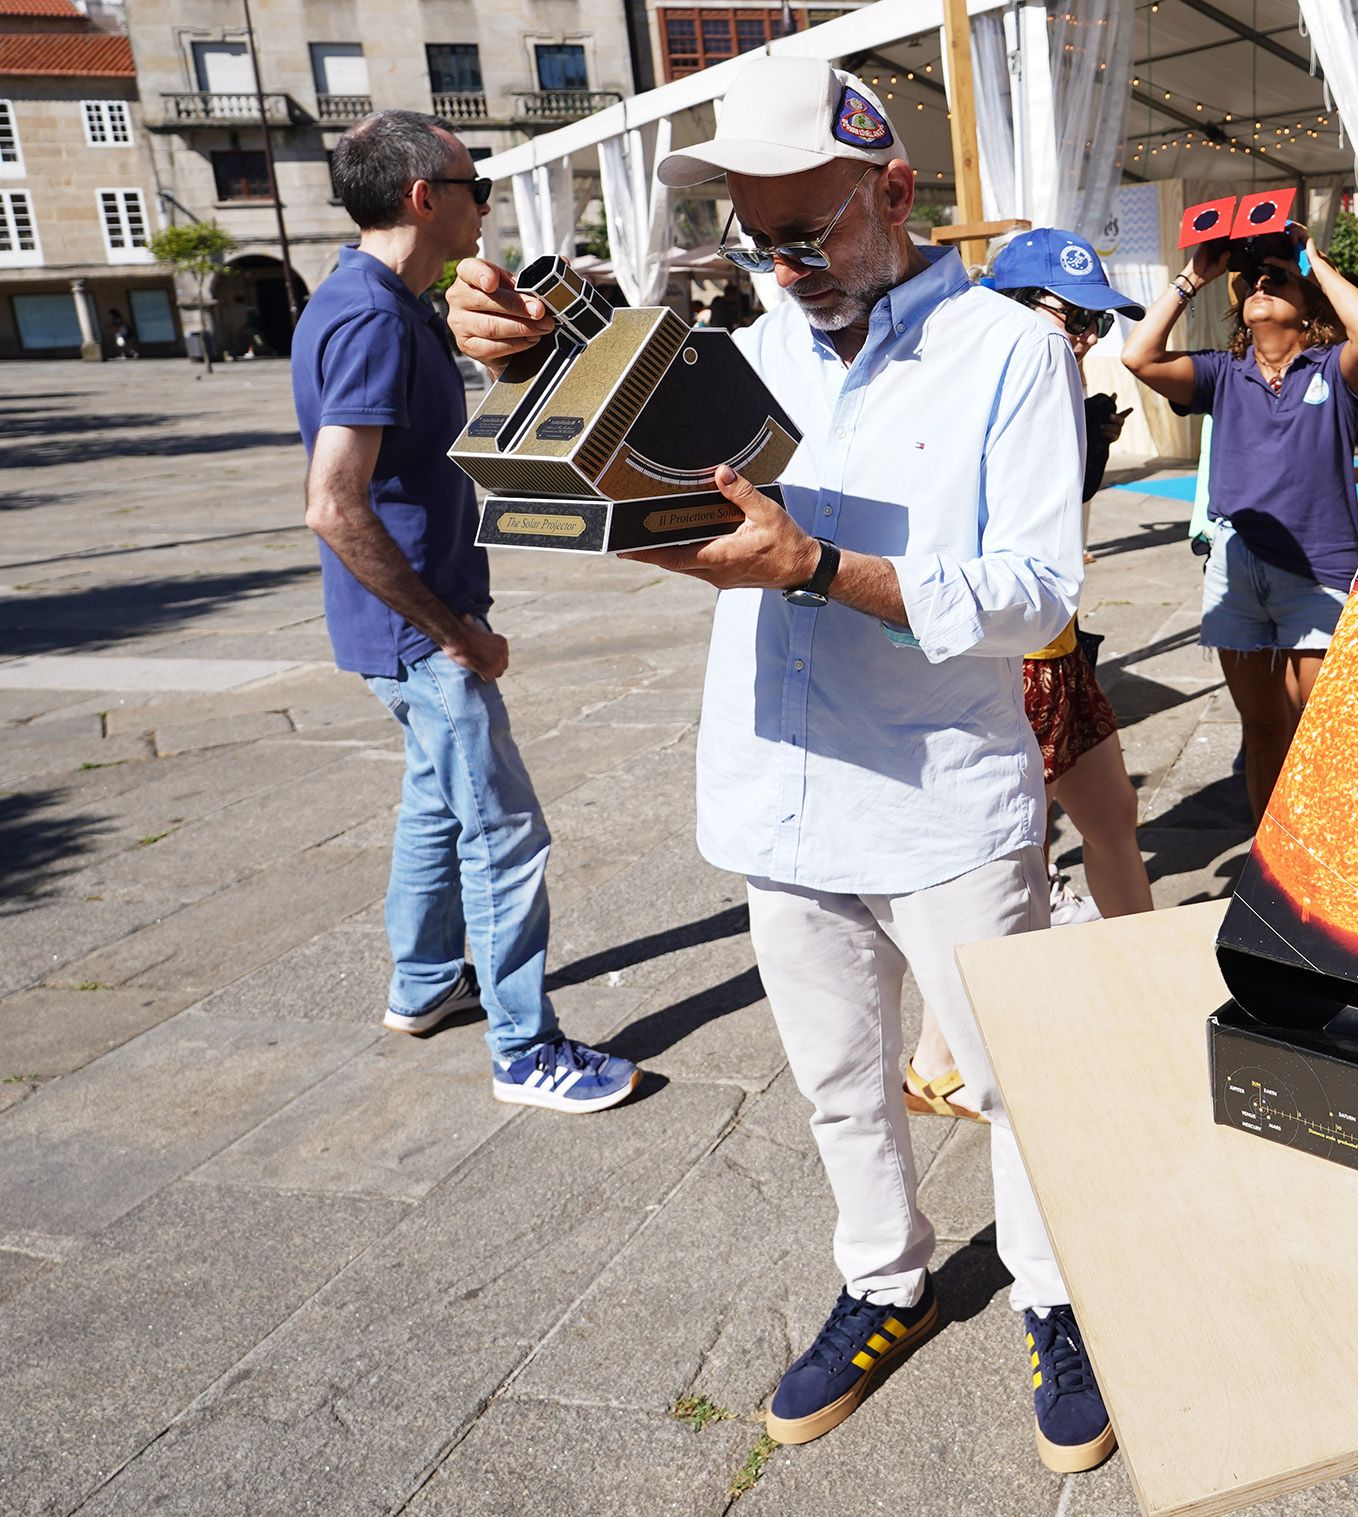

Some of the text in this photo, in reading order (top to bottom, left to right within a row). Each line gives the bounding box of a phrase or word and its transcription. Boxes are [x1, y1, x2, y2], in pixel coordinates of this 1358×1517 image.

[669, 511, 715, 525] Proiettore
[506, 517, 577, 532] The Solar Projector
[1263, 1087, 1278, 1097] EARTH
[1338, 1111, 1357, 1122] SATURN
[1268, 1123, 1282, 1131] MARS
